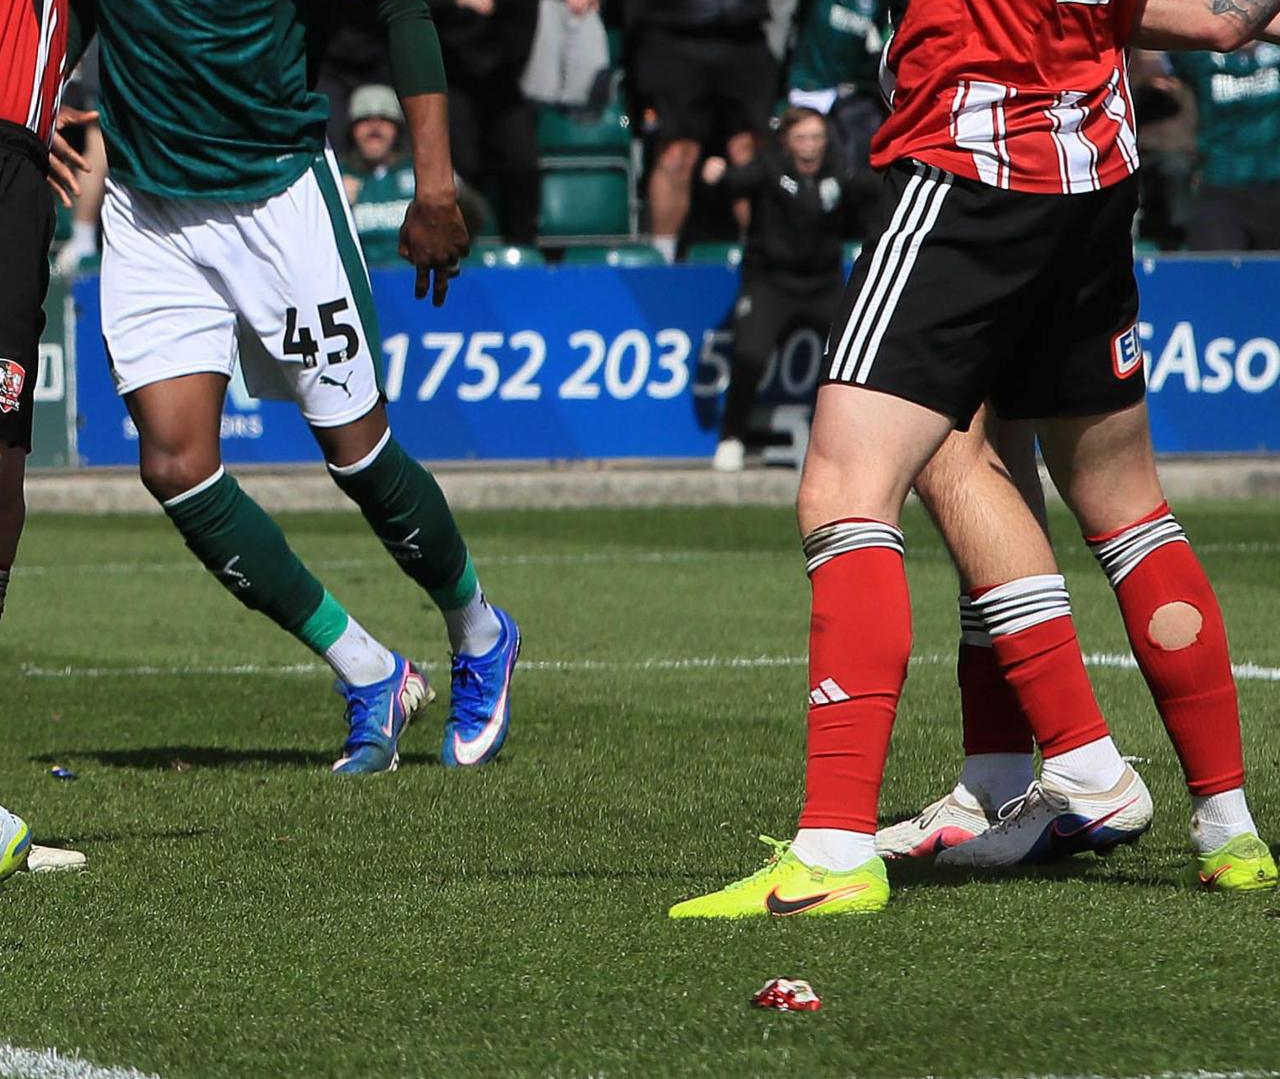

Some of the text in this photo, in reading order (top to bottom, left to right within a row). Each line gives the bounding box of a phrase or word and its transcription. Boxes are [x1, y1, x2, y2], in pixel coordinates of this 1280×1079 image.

[282, 296, 360, 369] 45
[383, 328, 824, 402] 1752 20350
